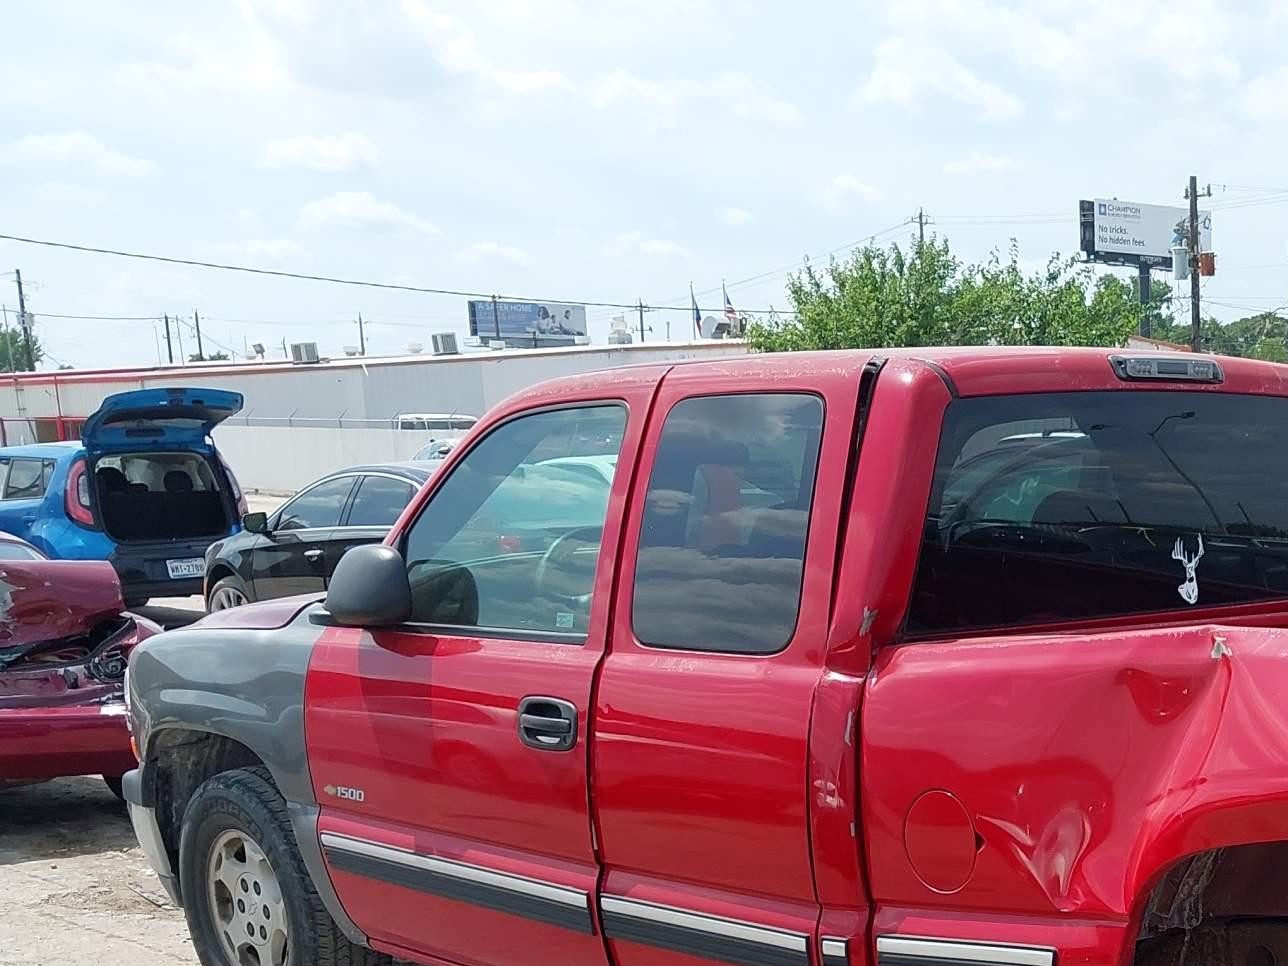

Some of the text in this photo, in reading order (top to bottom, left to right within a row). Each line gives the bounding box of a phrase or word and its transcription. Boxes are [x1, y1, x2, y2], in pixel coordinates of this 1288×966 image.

[1098, 224, 1129, 235] No tricks.
[1098, 235, 1108, 243] No
[1109, 236, 1131, 246] hidden
[510, 303, 532, 312] HOME
[336, 786, 365, 802] 1500
